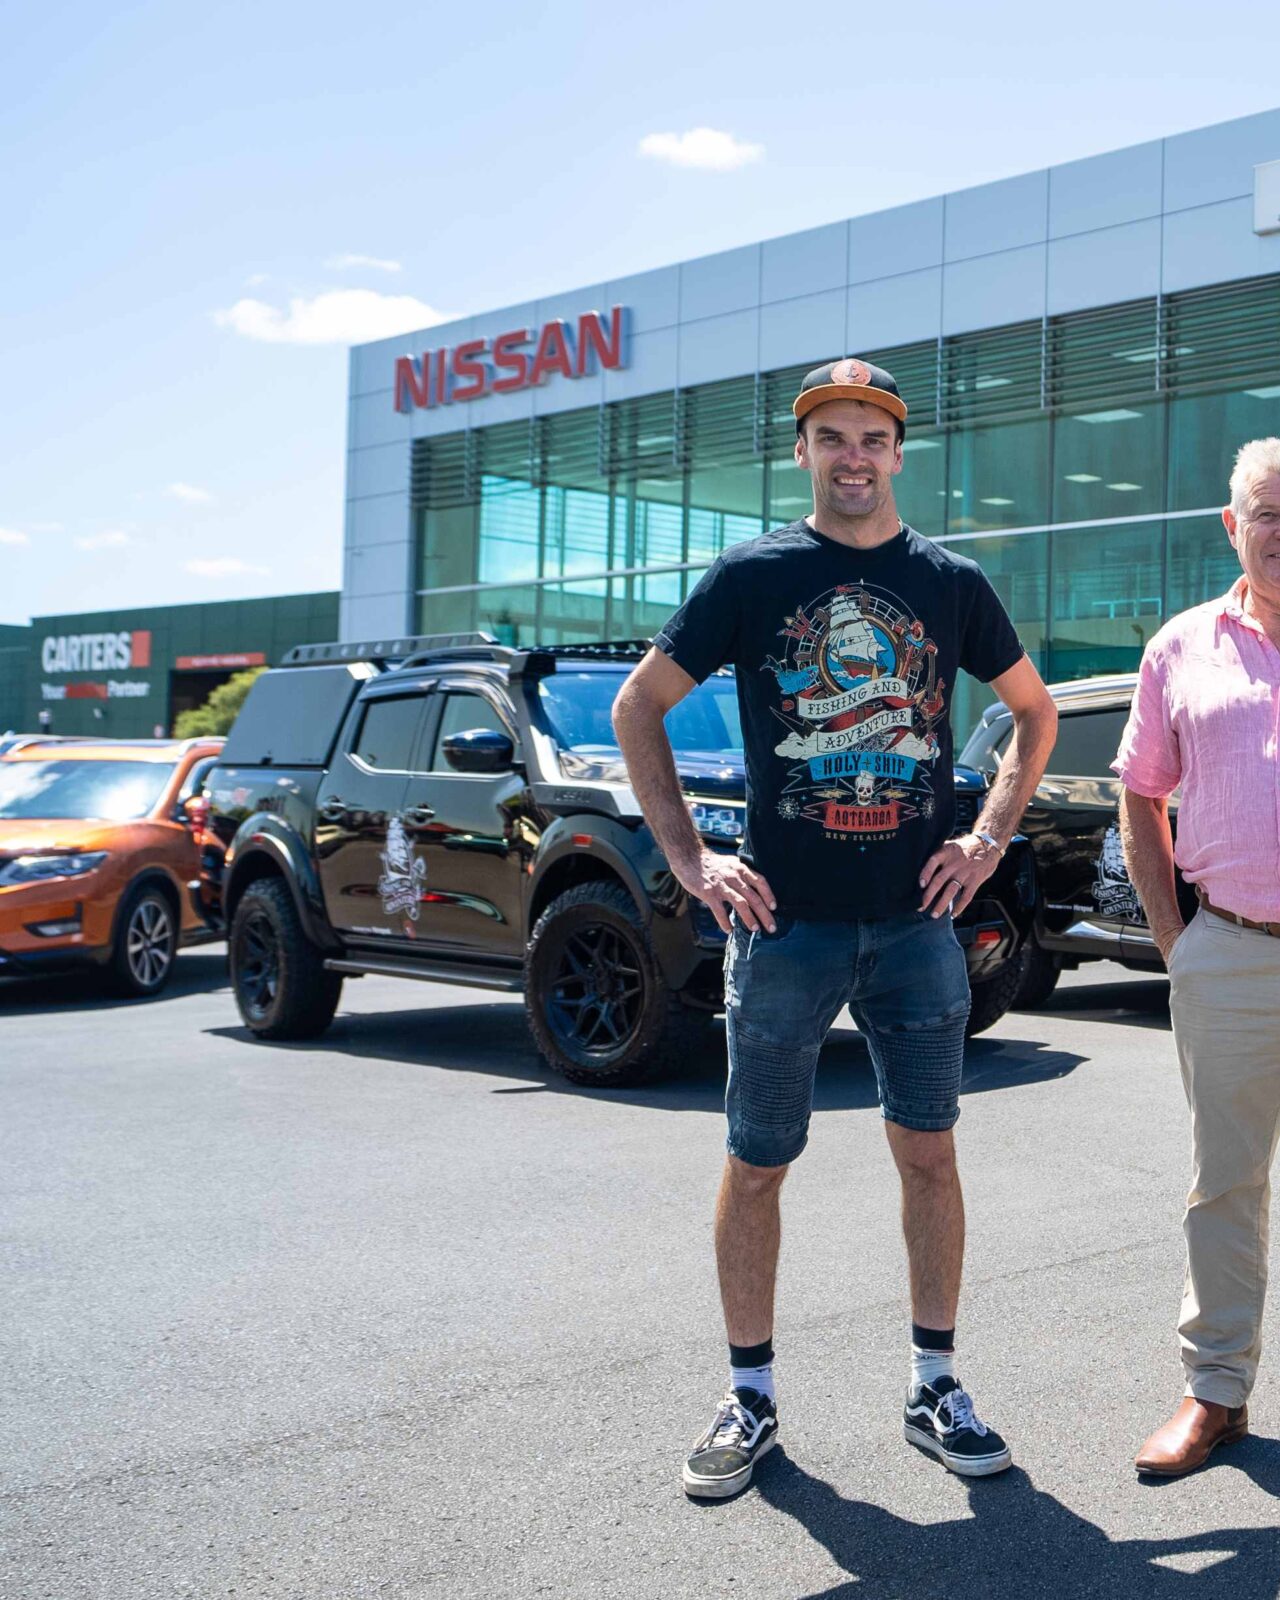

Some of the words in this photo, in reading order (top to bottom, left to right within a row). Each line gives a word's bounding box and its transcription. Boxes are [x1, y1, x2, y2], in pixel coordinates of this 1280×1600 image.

[393, 303, 630, 413] NISSAN
[42, 631, 132, 674] CARTERS
[808, 687, 868, 715] FISHING
[871, 681, 901, 696] AND
[824, 710, 907, 749] ADVENTURE
[823, 754, 860, 776] HOLY
[874, 755, 905, 775] SHIP
[834, 809, 891, 827] AOTEAROA
